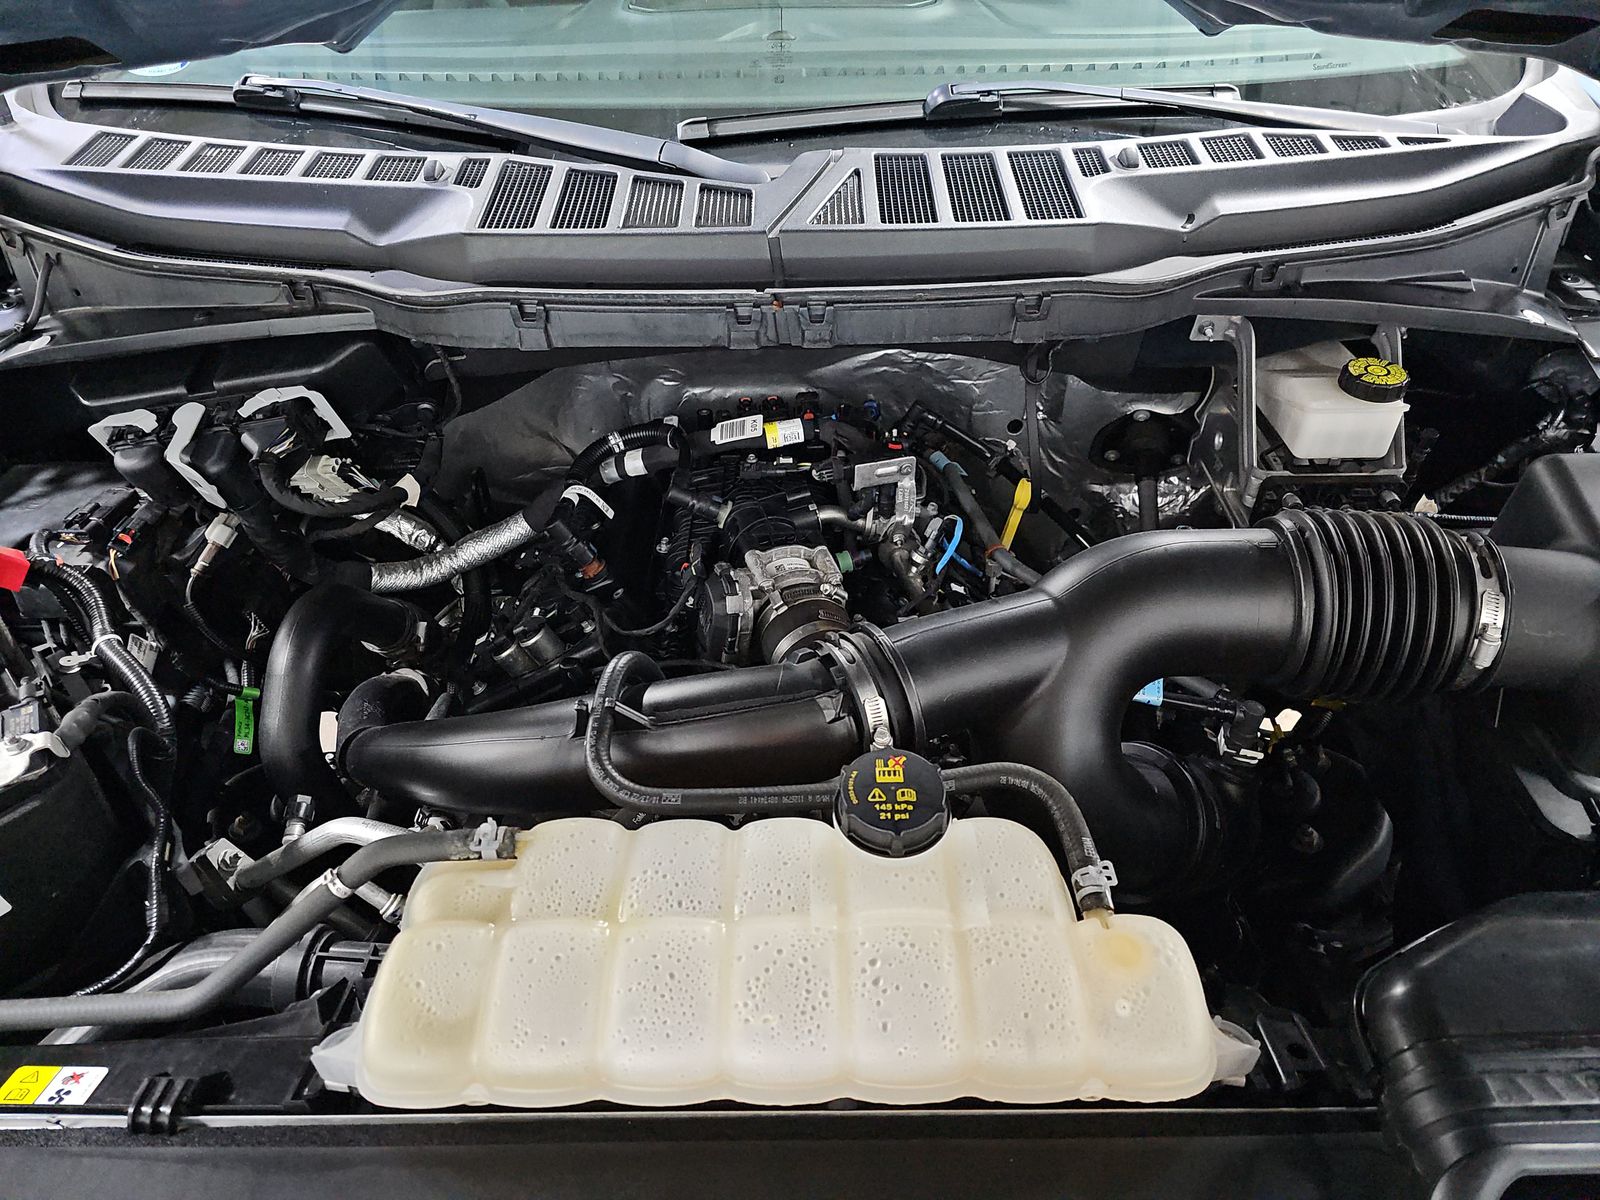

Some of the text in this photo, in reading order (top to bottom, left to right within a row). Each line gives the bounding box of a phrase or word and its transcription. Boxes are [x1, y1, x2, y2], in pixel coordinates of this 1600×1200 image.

[874, 803, 914, 811] 145 kPa
[879, 812, 910, 821] 21 psi
